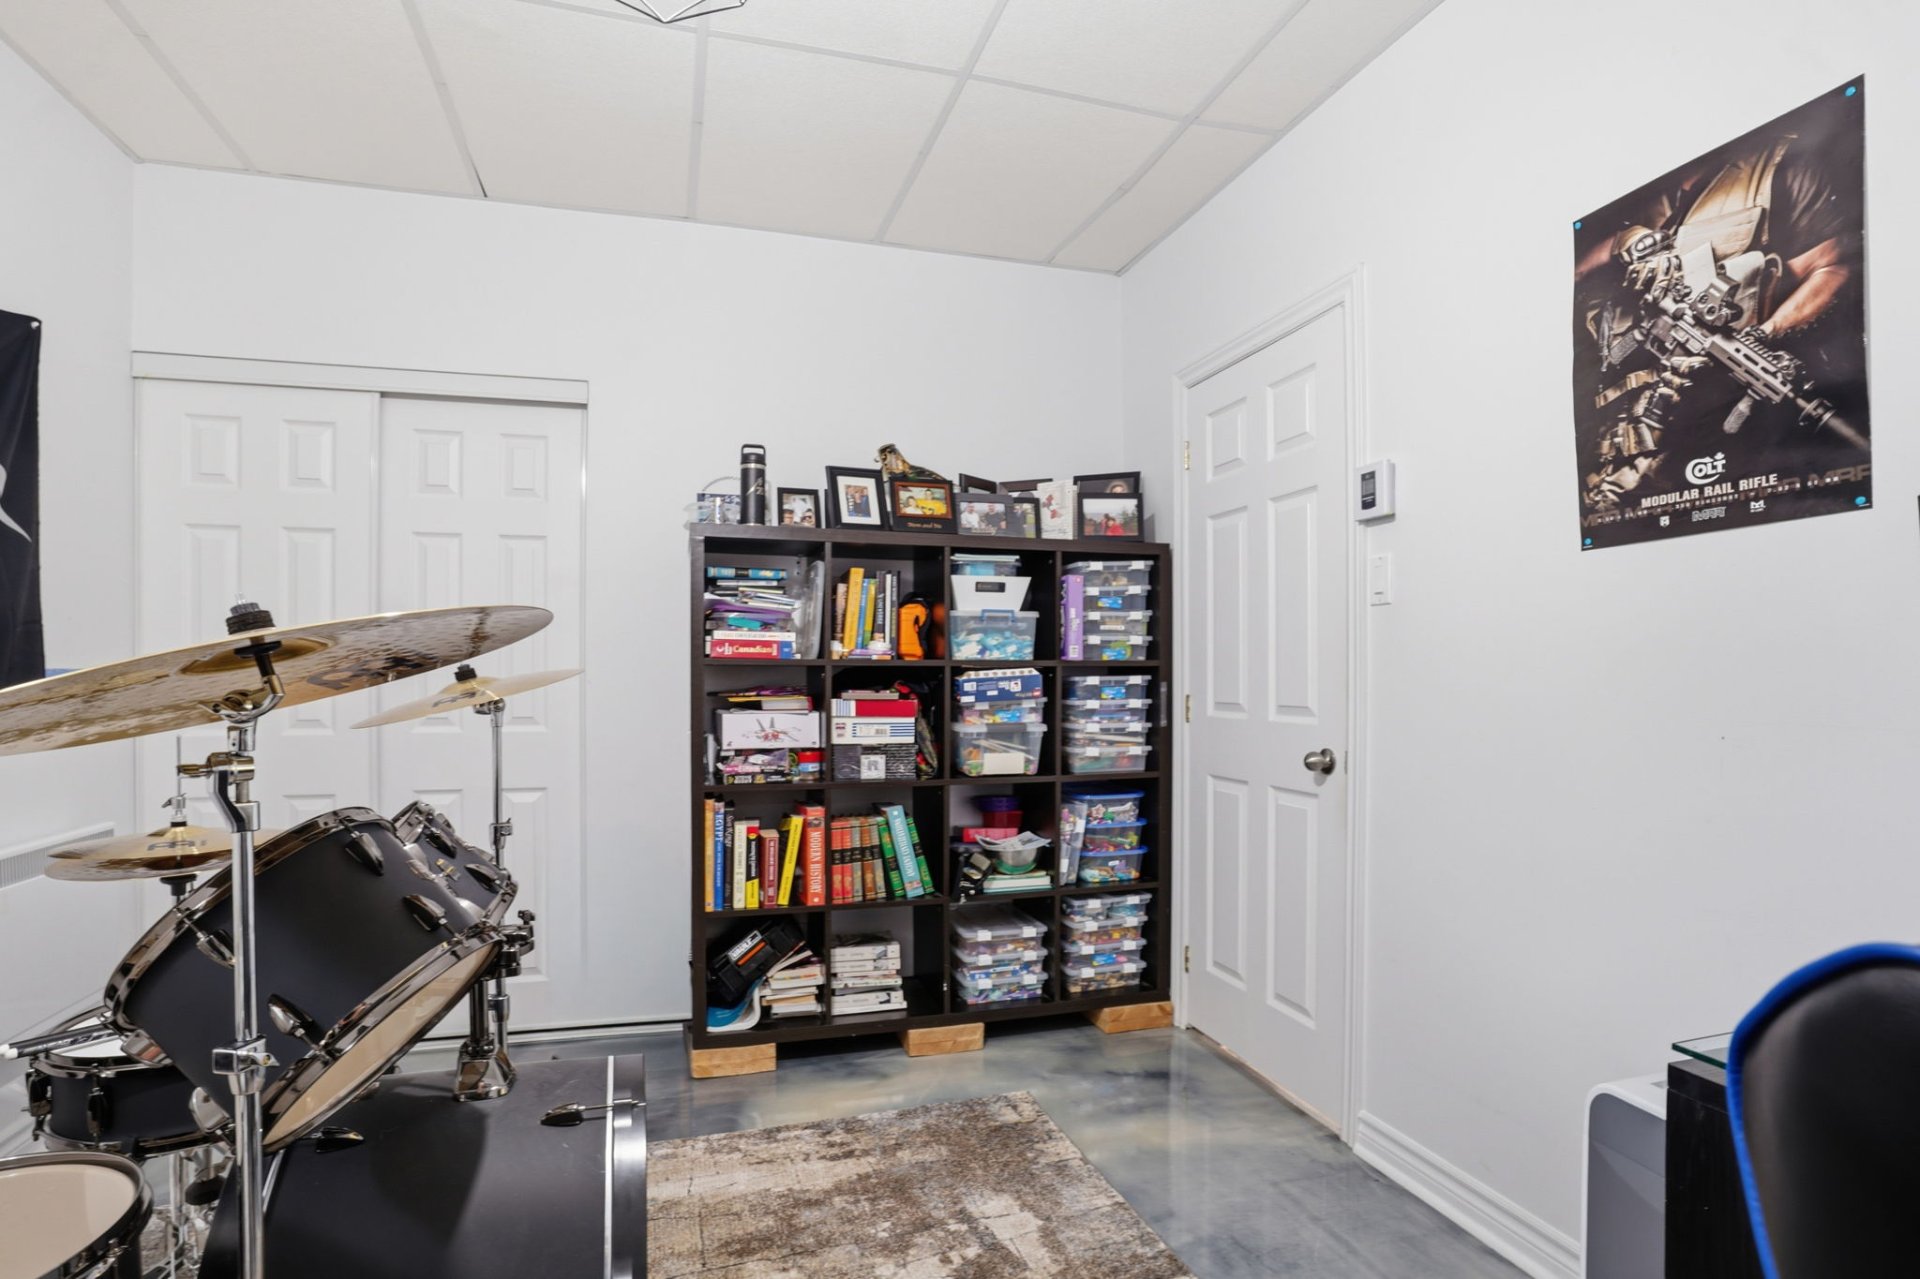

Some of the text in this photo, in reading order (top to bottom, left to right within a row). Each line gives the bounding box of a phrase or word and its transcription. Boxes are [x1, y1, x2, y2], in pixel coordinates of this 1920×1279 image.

[1685, 454, 1727, 485] COLT
[1641, 488, 1700, 509] MODULAR
[1703, 482, 1735, 498] RAIL
[1738, 473, 1778, 492] RIFLE
[715, 814, 724, 841] EGYPT
[809, 831, 822, 893] MODERN HISTORY
